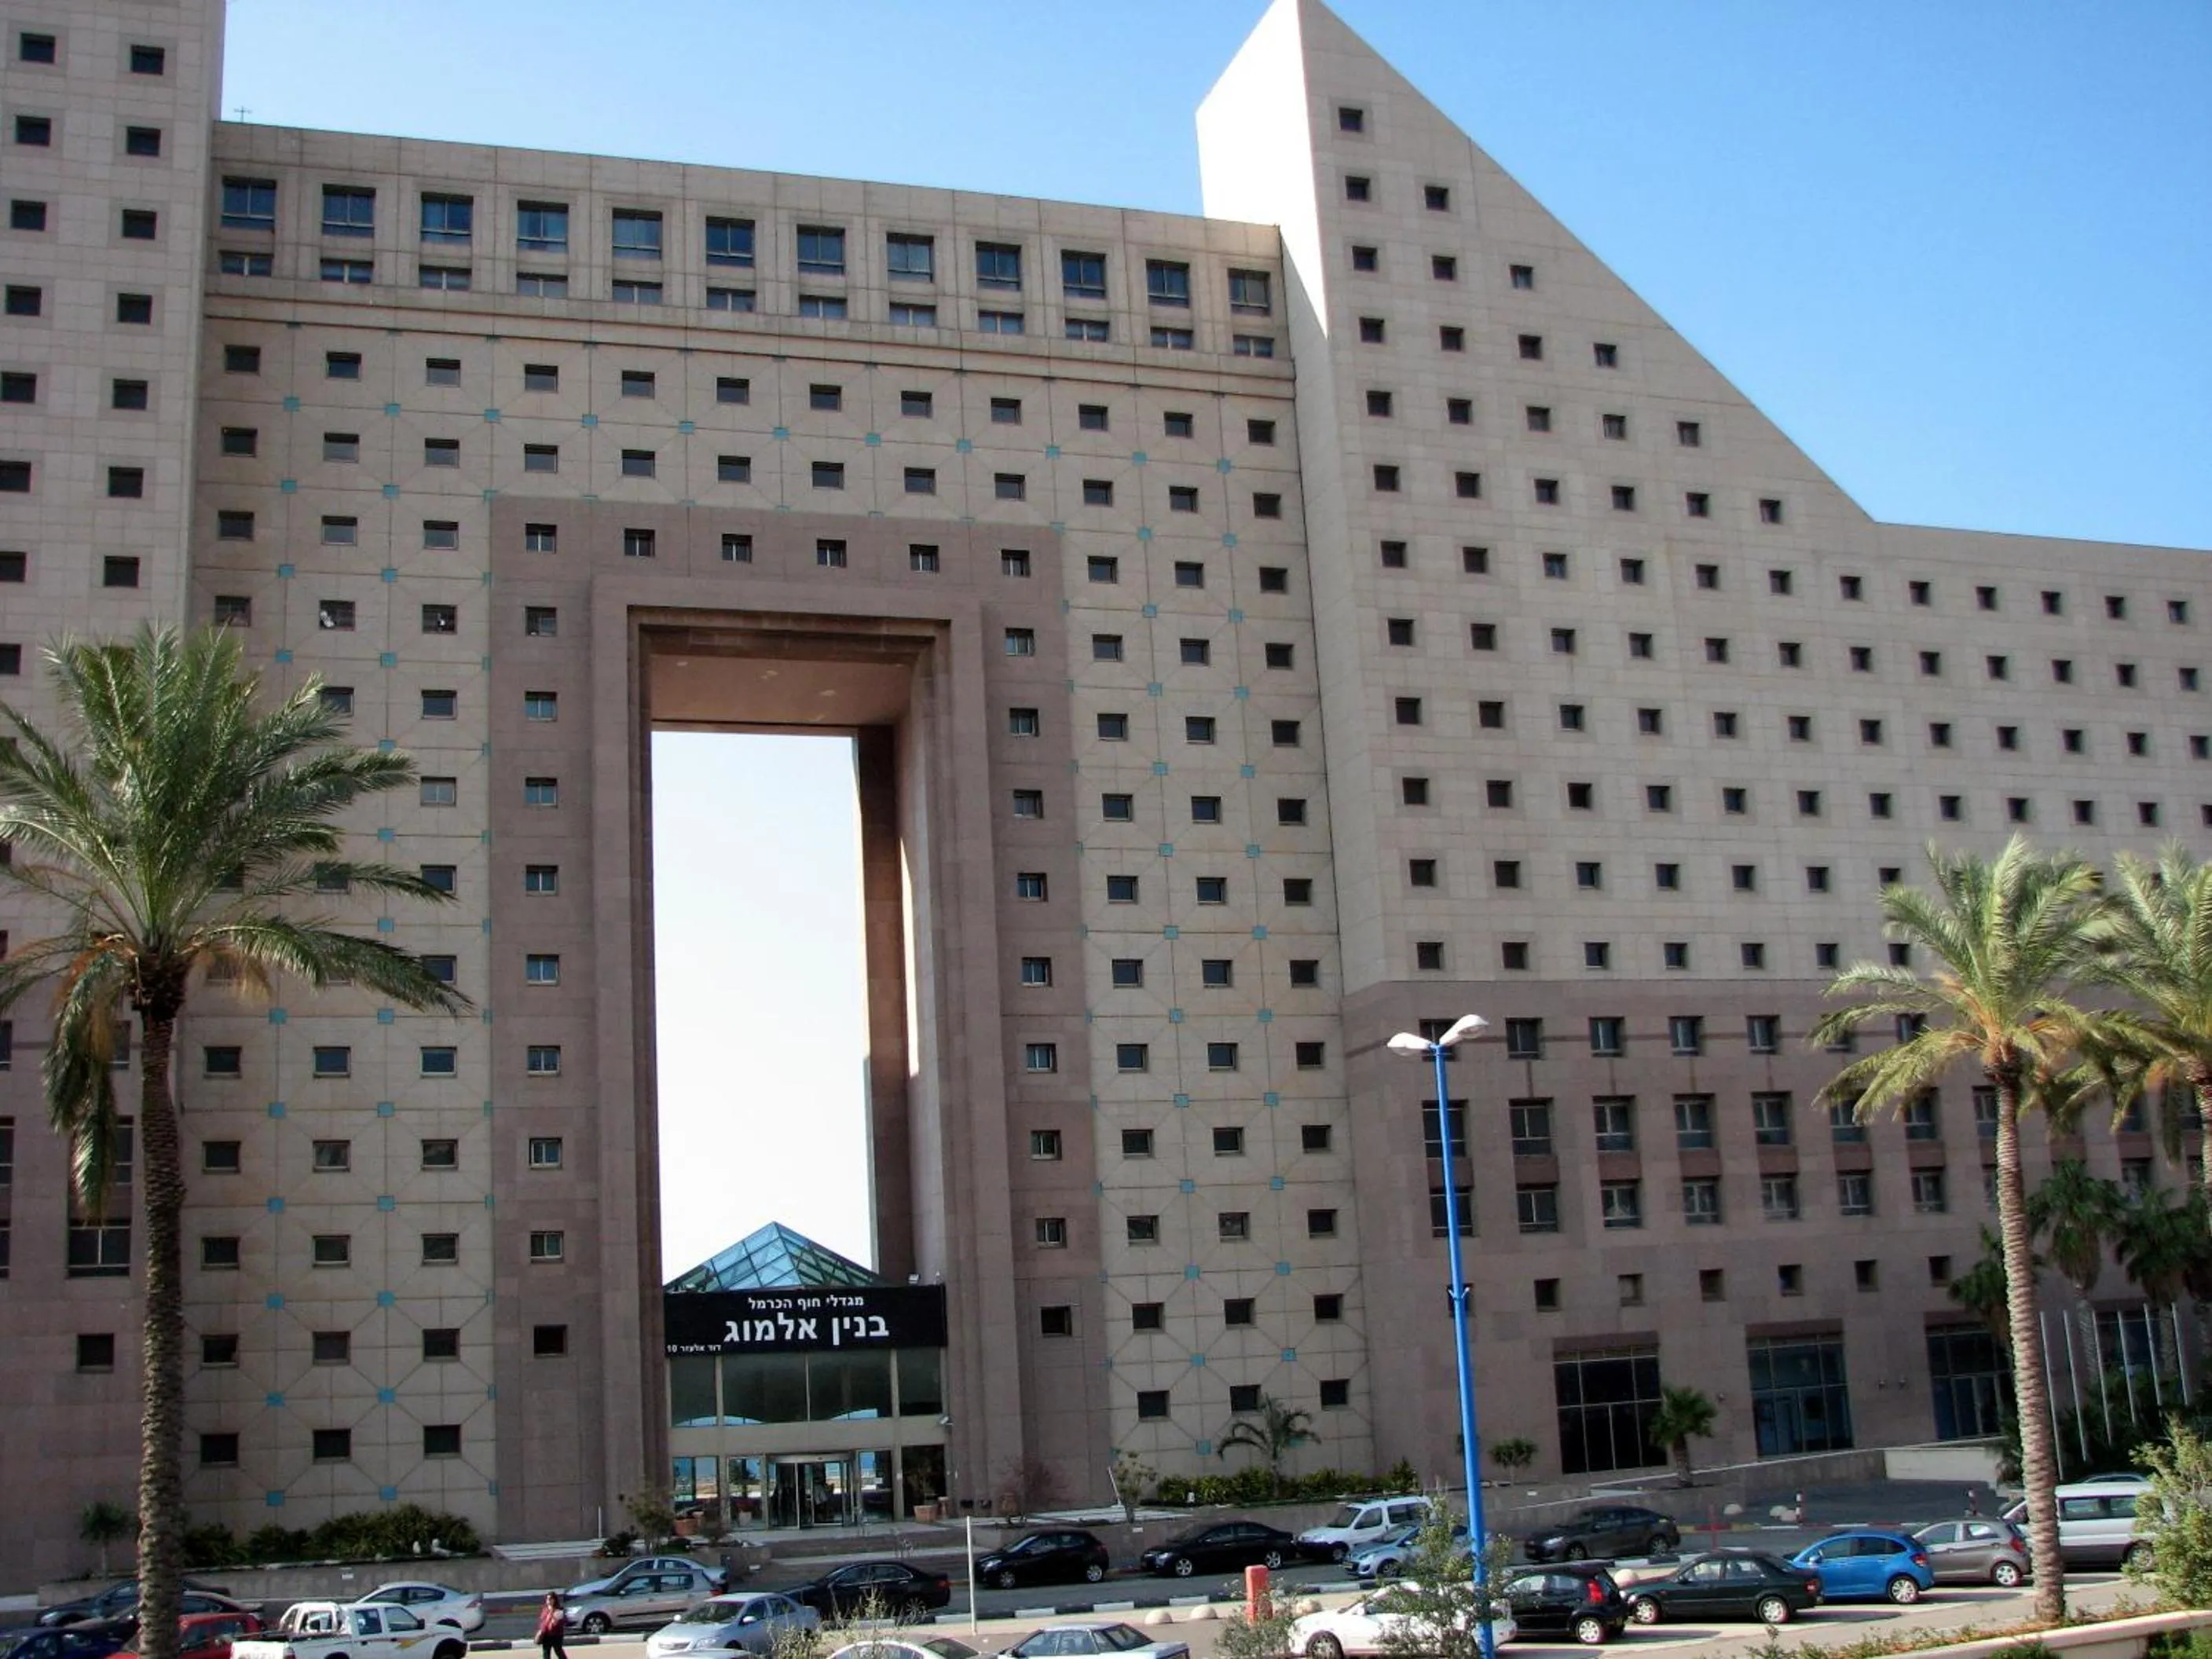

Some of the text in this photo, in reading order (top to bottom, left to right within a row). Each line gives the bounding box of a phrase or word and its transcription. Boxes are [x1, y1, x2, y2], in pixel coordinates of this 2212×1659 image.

[748, 1294, 864, 1311] מגדלי חוף הכרמל
[723, 1312, 889, 1346] בנין אלמוג
[667, 1344, 678, 1353] 10
